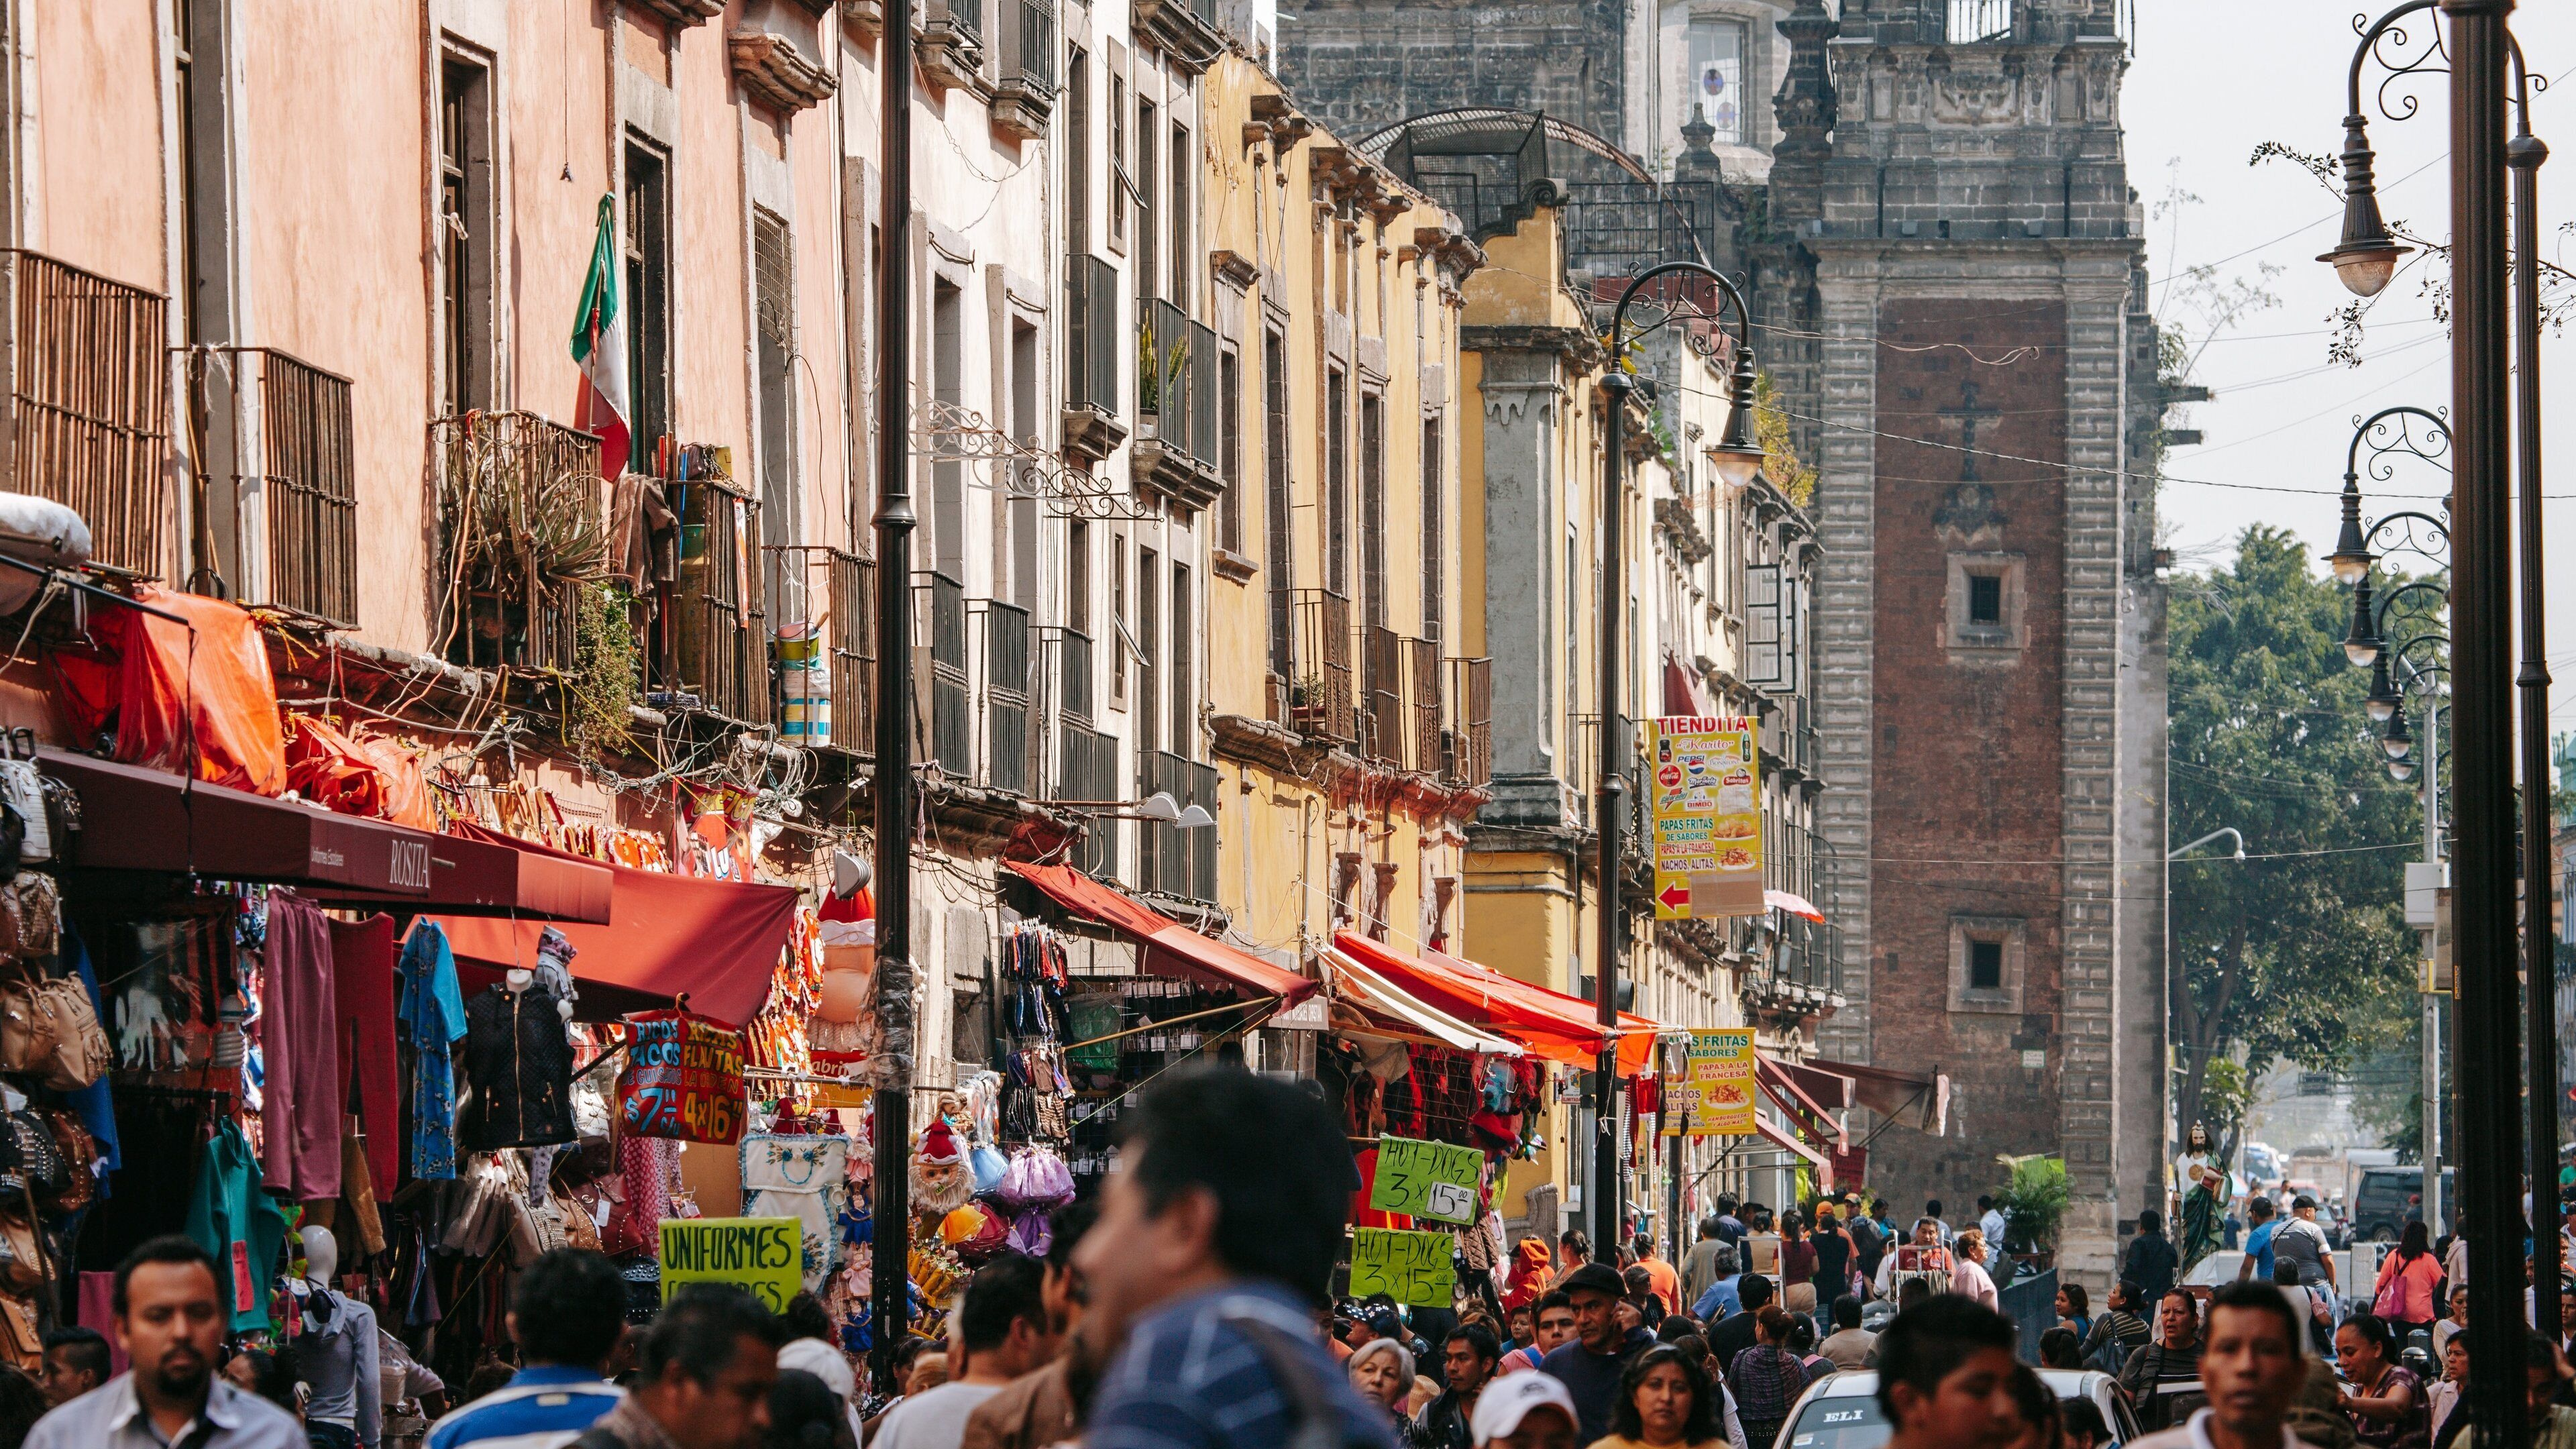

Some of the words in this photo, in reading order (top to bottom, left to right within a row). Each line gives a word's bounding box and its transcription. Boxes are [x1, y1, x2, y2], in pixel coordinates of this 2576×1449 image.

[1656, 715, 1749, 735] TIENDITA
[1677, 755, 1705, 763] PEPSI
[1688, 776, 1717, 786] Marinela
[1660, 818, 1684, 831] PAPAS
[1686, 817, 1713, 830] FRITAS
[1666, 833, 1675, 841] DE
[1677, 832, 1708, 841] SABORES
[1661, 843, 1675, 855] PAPAS
[1676, 843, 1680, 854] A
[1681, 843, 1688, 853] LA
[1688, 841, 1715, 853] FRANCESA
[389, 840, 429, 888] ROSITA
[635, 1020, 679, 1042] RICOS
[687, 1021, 738, 1050] RICAS
[1704, 1035, 1748, 1047] FRITAS
[631, 1042, 681, 1067] TACOS
[684, 1044, 744, 1077] FLAUTAS
[1688, 1049, 1738, 1057] SABORES
[637, 1067, 682, 1085] GUISADOS
[684, 1070, 697, 1087] LA
[700, 1071, 739, 1093] ORDEN
[1700, 1071, 1748, 1080] FRANCESA
[1668, 1090, 1701, 1099] ACHOS
[1707, 1112, 1750, 1122] HAMBURGUESAS
[1385, 1138, 1480, 1185] HOT-DOGS
[1385, 1173, 1409, 1208] 3
[663, 1226, 792, 1271] UNIFORMES
[1356, 1228, 1453, 1270] HOT-DOGS
[1360, 1264, 1387, 1298] 3
[1823, 1409, 1864, 1423] ELI
